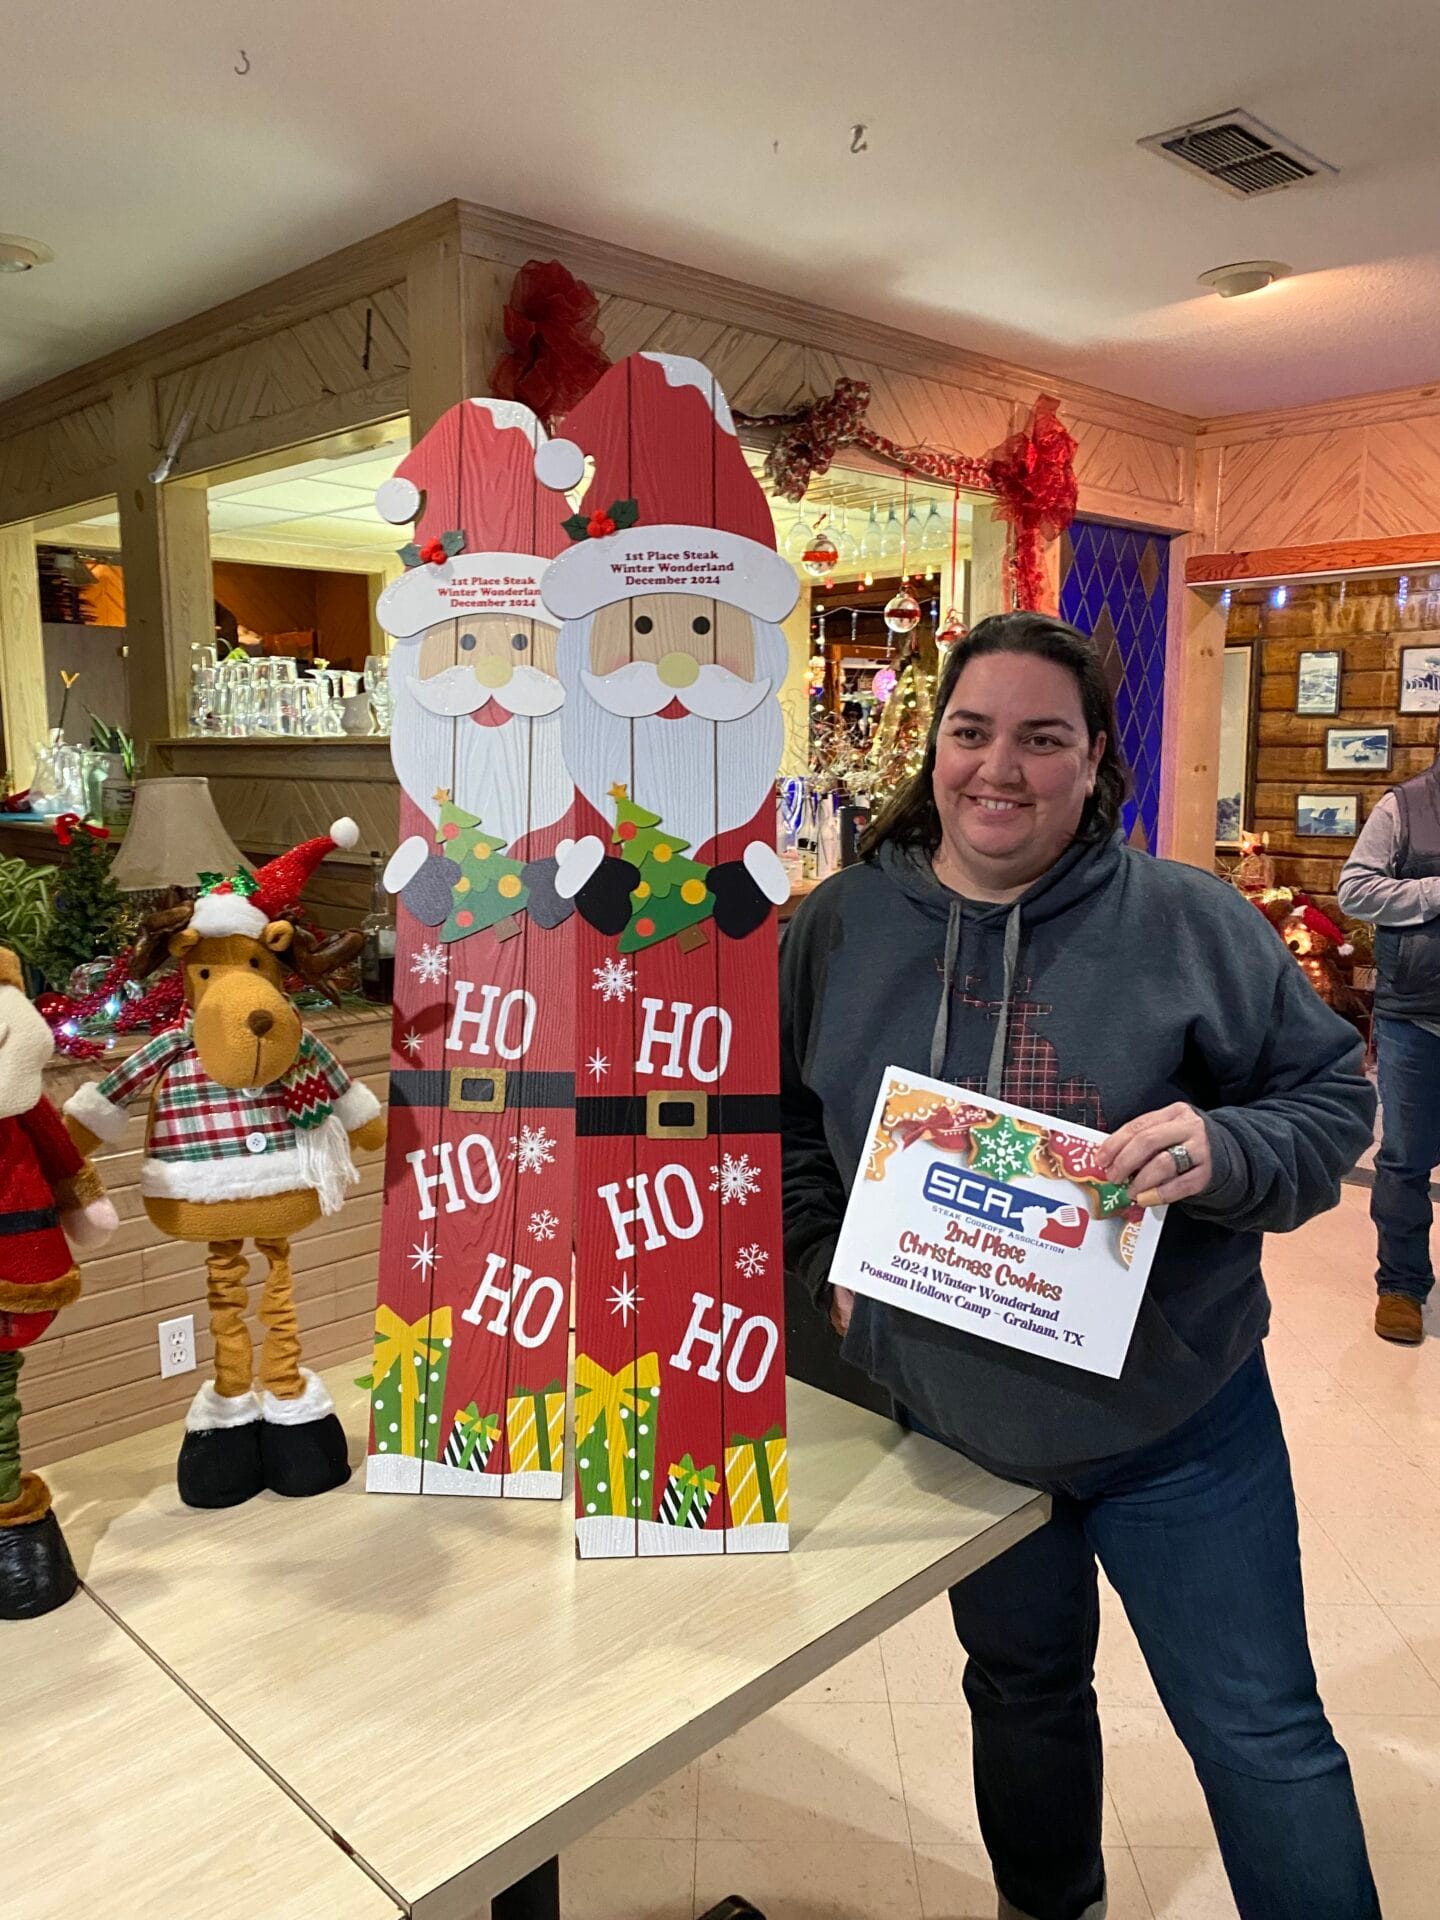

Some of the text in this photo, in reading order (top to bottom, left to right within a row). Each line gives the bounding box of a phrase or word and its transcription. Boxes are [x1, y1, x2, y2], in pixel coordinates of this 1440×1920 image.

[471, 576, 500, 585] Place
[503, 576, 536, 585] Steak
[611, 562, 734, 573] Winter Wonderland
[625, 576, 720, 585] December 2024
[647, 552, 680, 560] Place
[683, 550, 719, 560] Steak
[438, 588, 542, 596] Winter Wonderlan
[450, 598, 536, 608] December 2024
[445, 980, 537, 1060] HO
[634, 997, 732, 1082] HO
[406, 1134, 502, 1220] HO
[928, 1169, 1013, 1218] SCA
[598, 1164, 704, 1260] HO
[945, 1220, 1026, 1264] 2nd Place
[891, 1255, 1060, 1322] 2024 Winter Wonderland
[900, 1230, 1063, 1302] Christmas Cookies
[461, 1253, 564, 1348] HO
[860, 1261, 908, 1288] Possum
[909, 1278, 954, 1304] Hollow
[954, 1296, 992, 1318] Camp
[1002, 1312, 1059, 1340] Graham,
[1062, 1329, 1086, 1346] TX
[670, 1292, 778, 1394] HO
